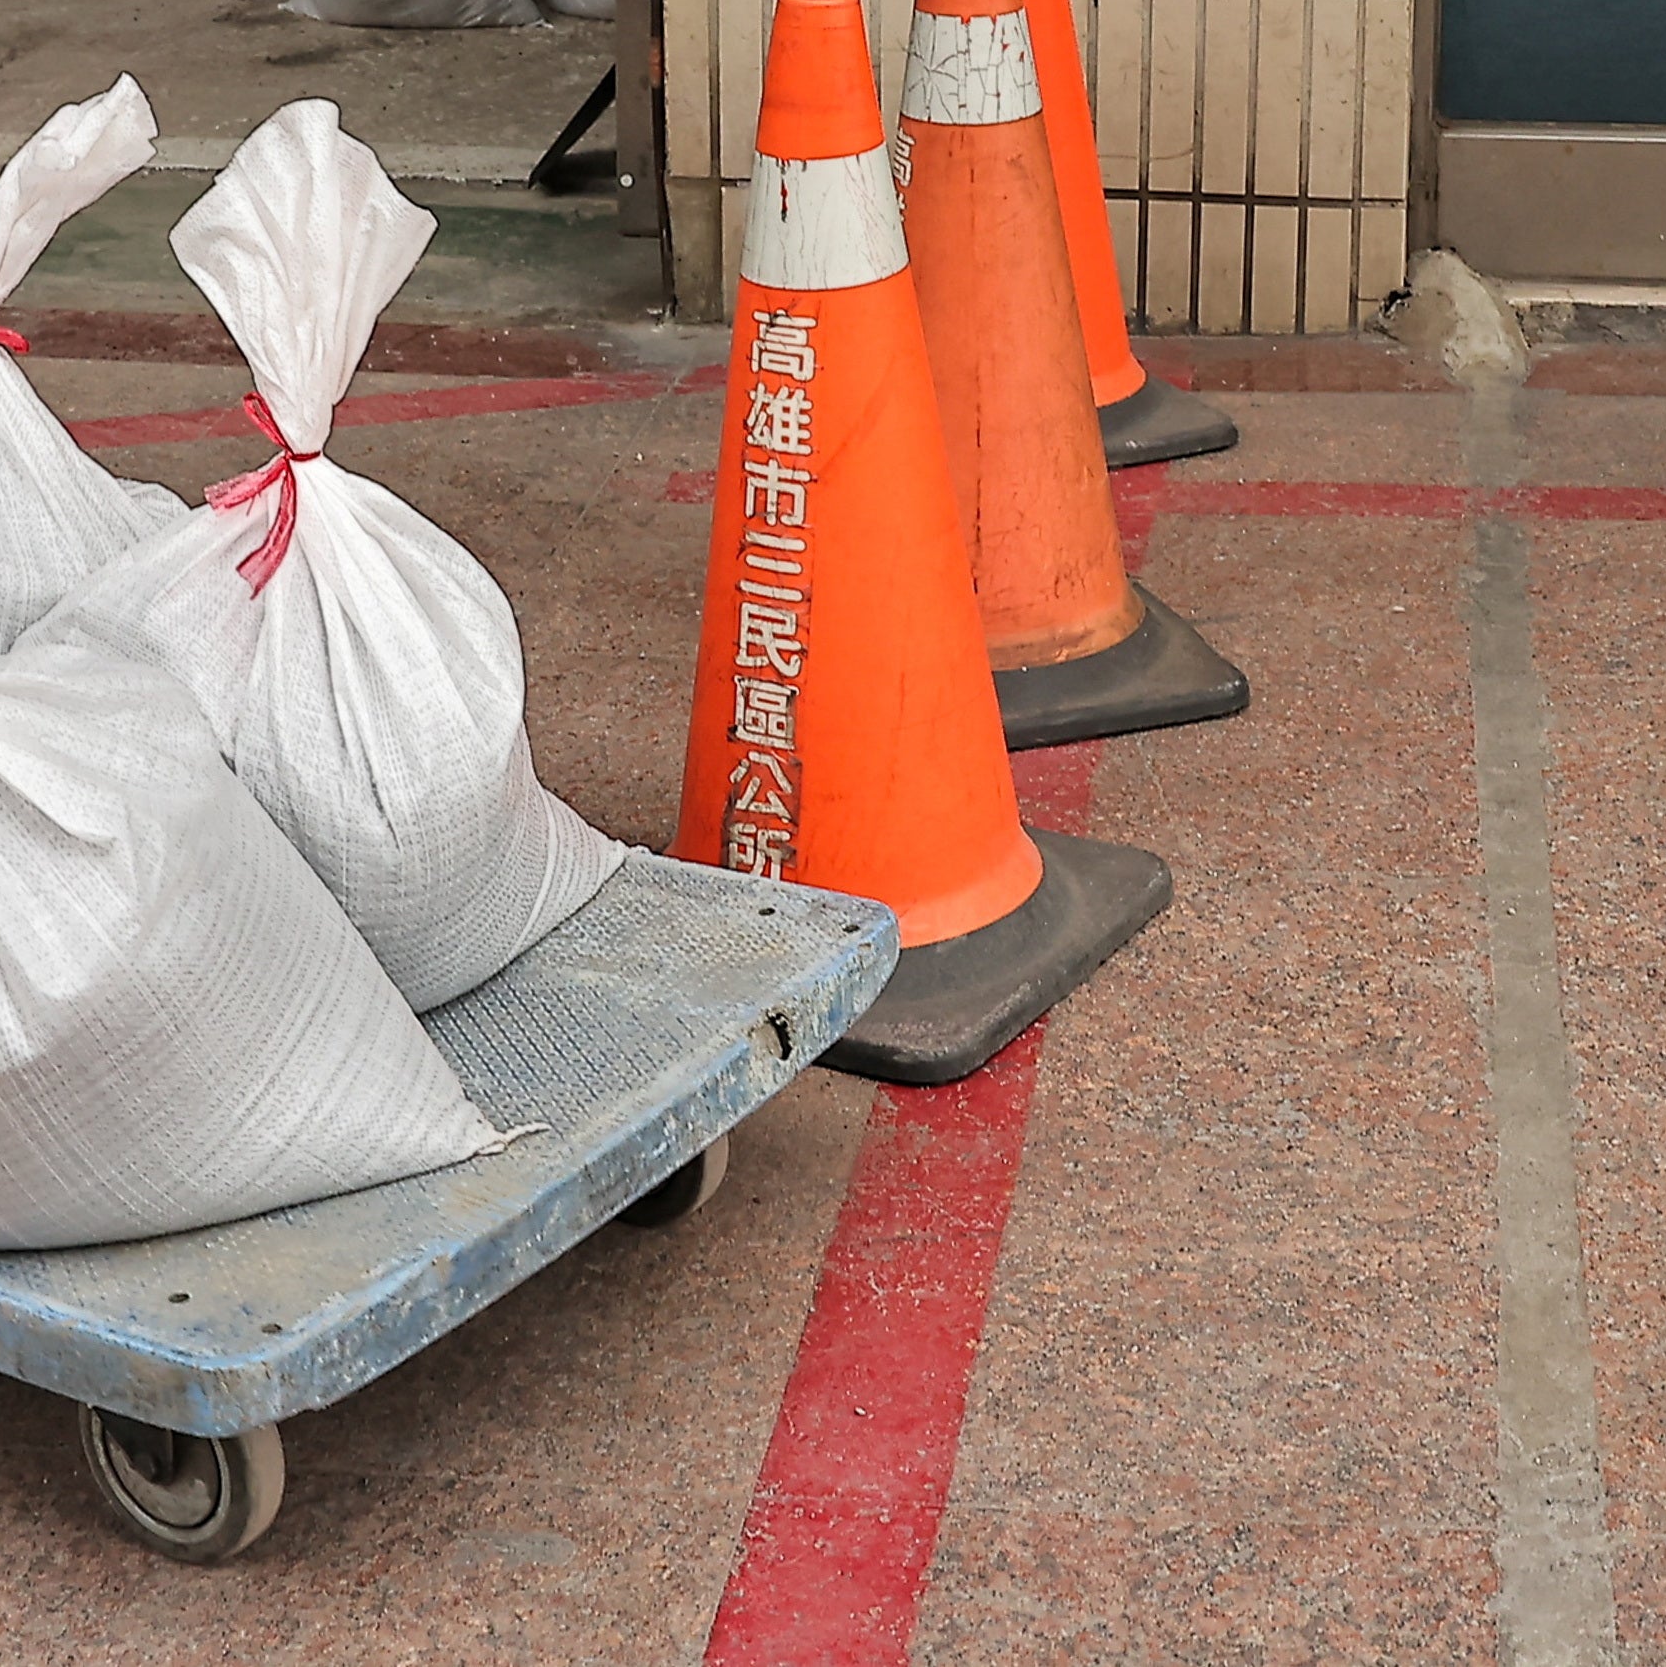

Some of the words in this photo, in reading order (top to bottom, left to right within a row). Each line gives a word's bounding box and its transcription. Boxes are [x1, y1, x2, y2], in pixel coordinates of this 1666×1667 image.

[726, 308, 817, 881] 高雄市三民區公所
